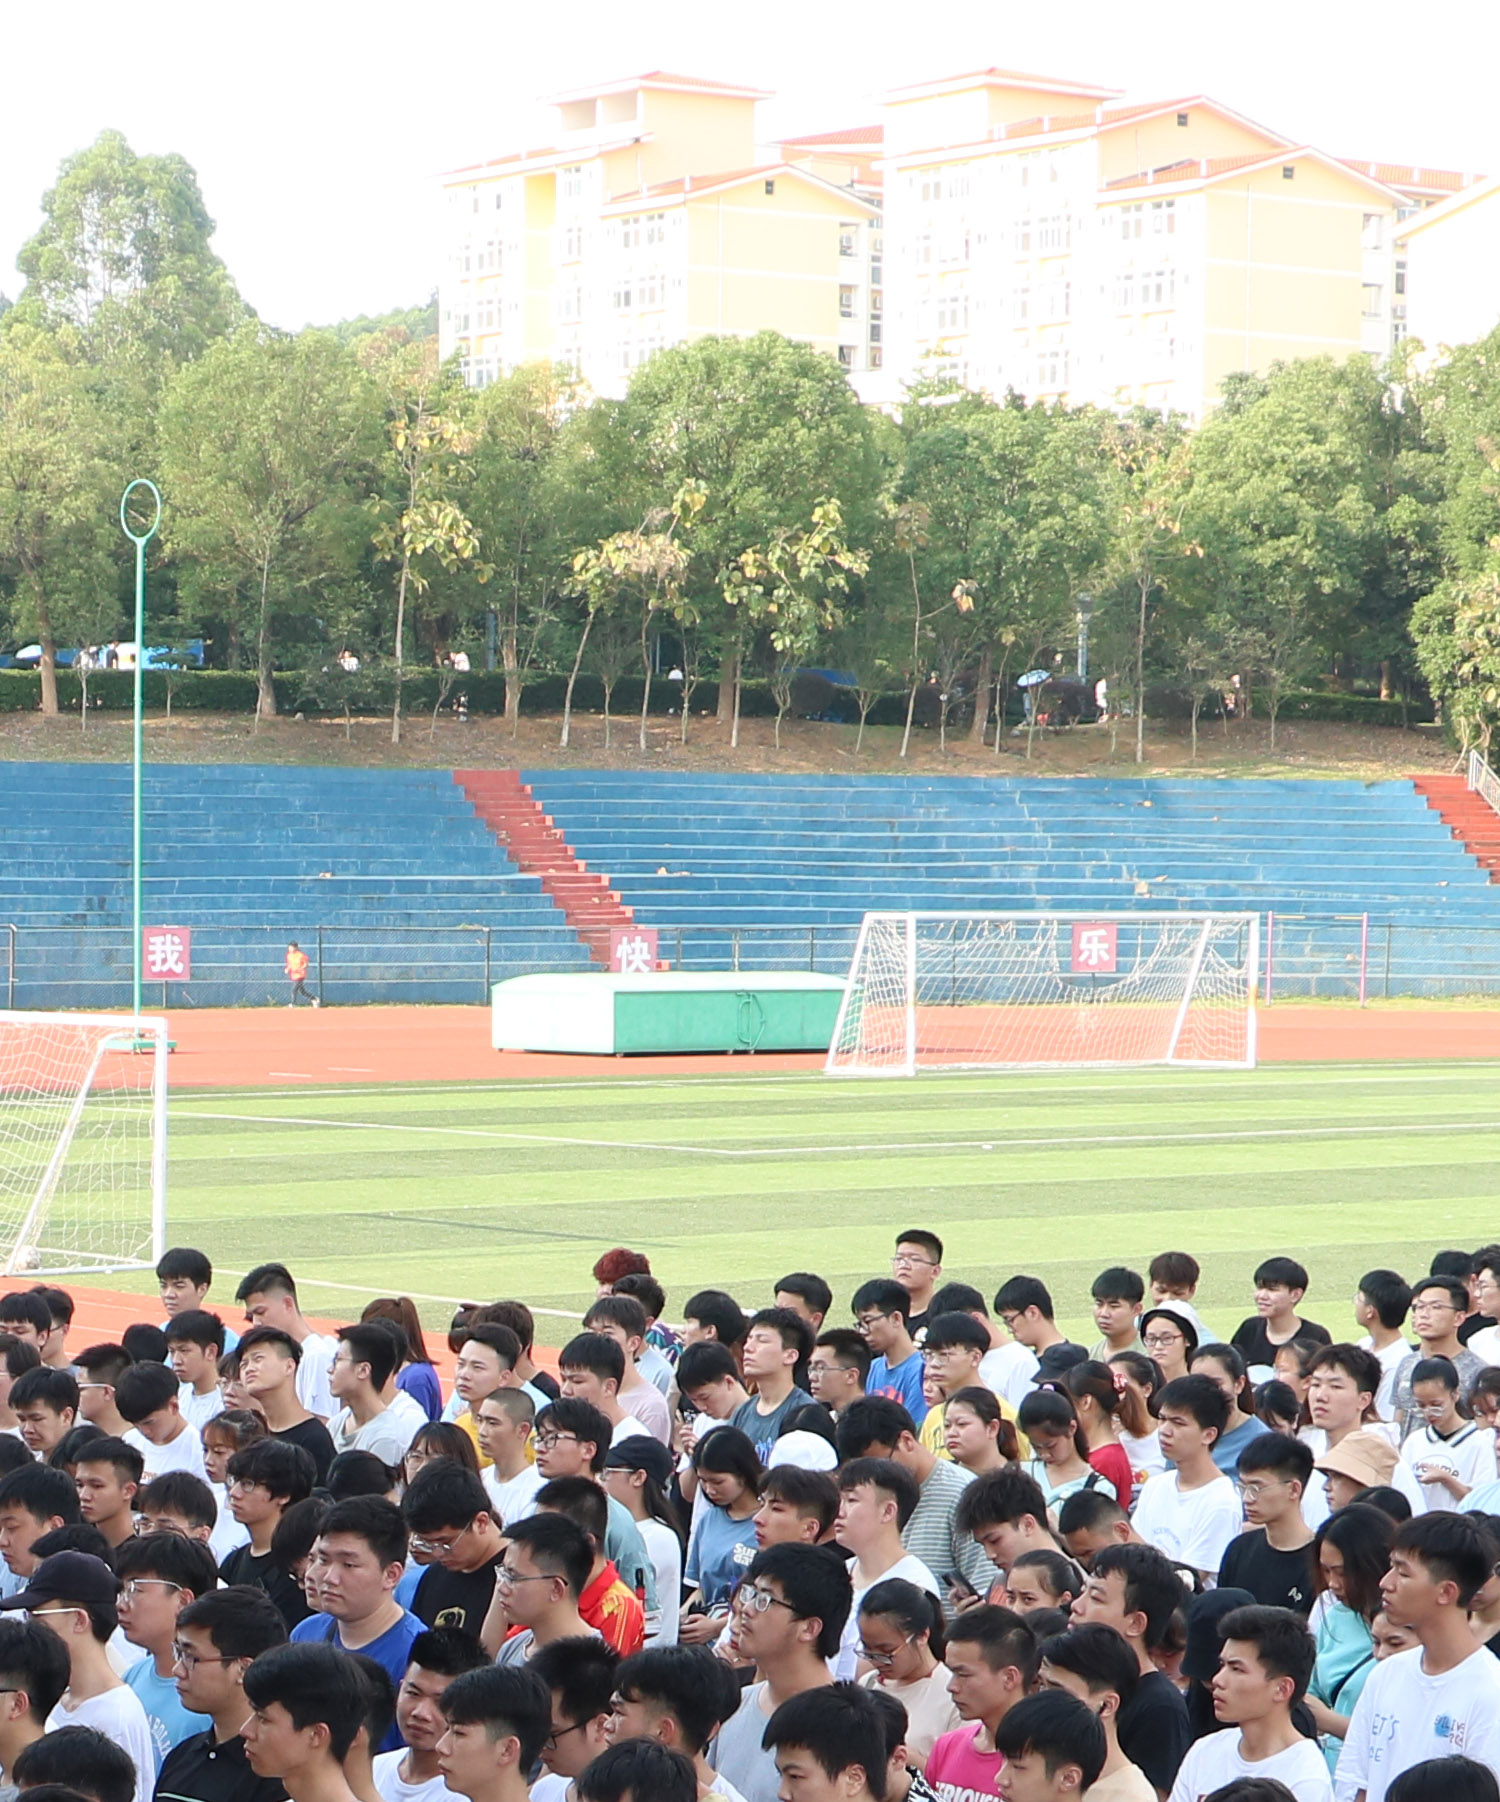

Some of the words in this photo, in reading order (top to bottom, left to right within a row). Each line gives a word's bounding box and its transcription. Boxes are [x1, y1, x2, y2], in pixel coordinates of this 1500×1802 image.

[148, 934, 183, 974] 我
[616, 936, 651, 973] 快
[1079, 929, 1110, 965] 乐
[1372, 1714, 1400, 1741] ET'S
